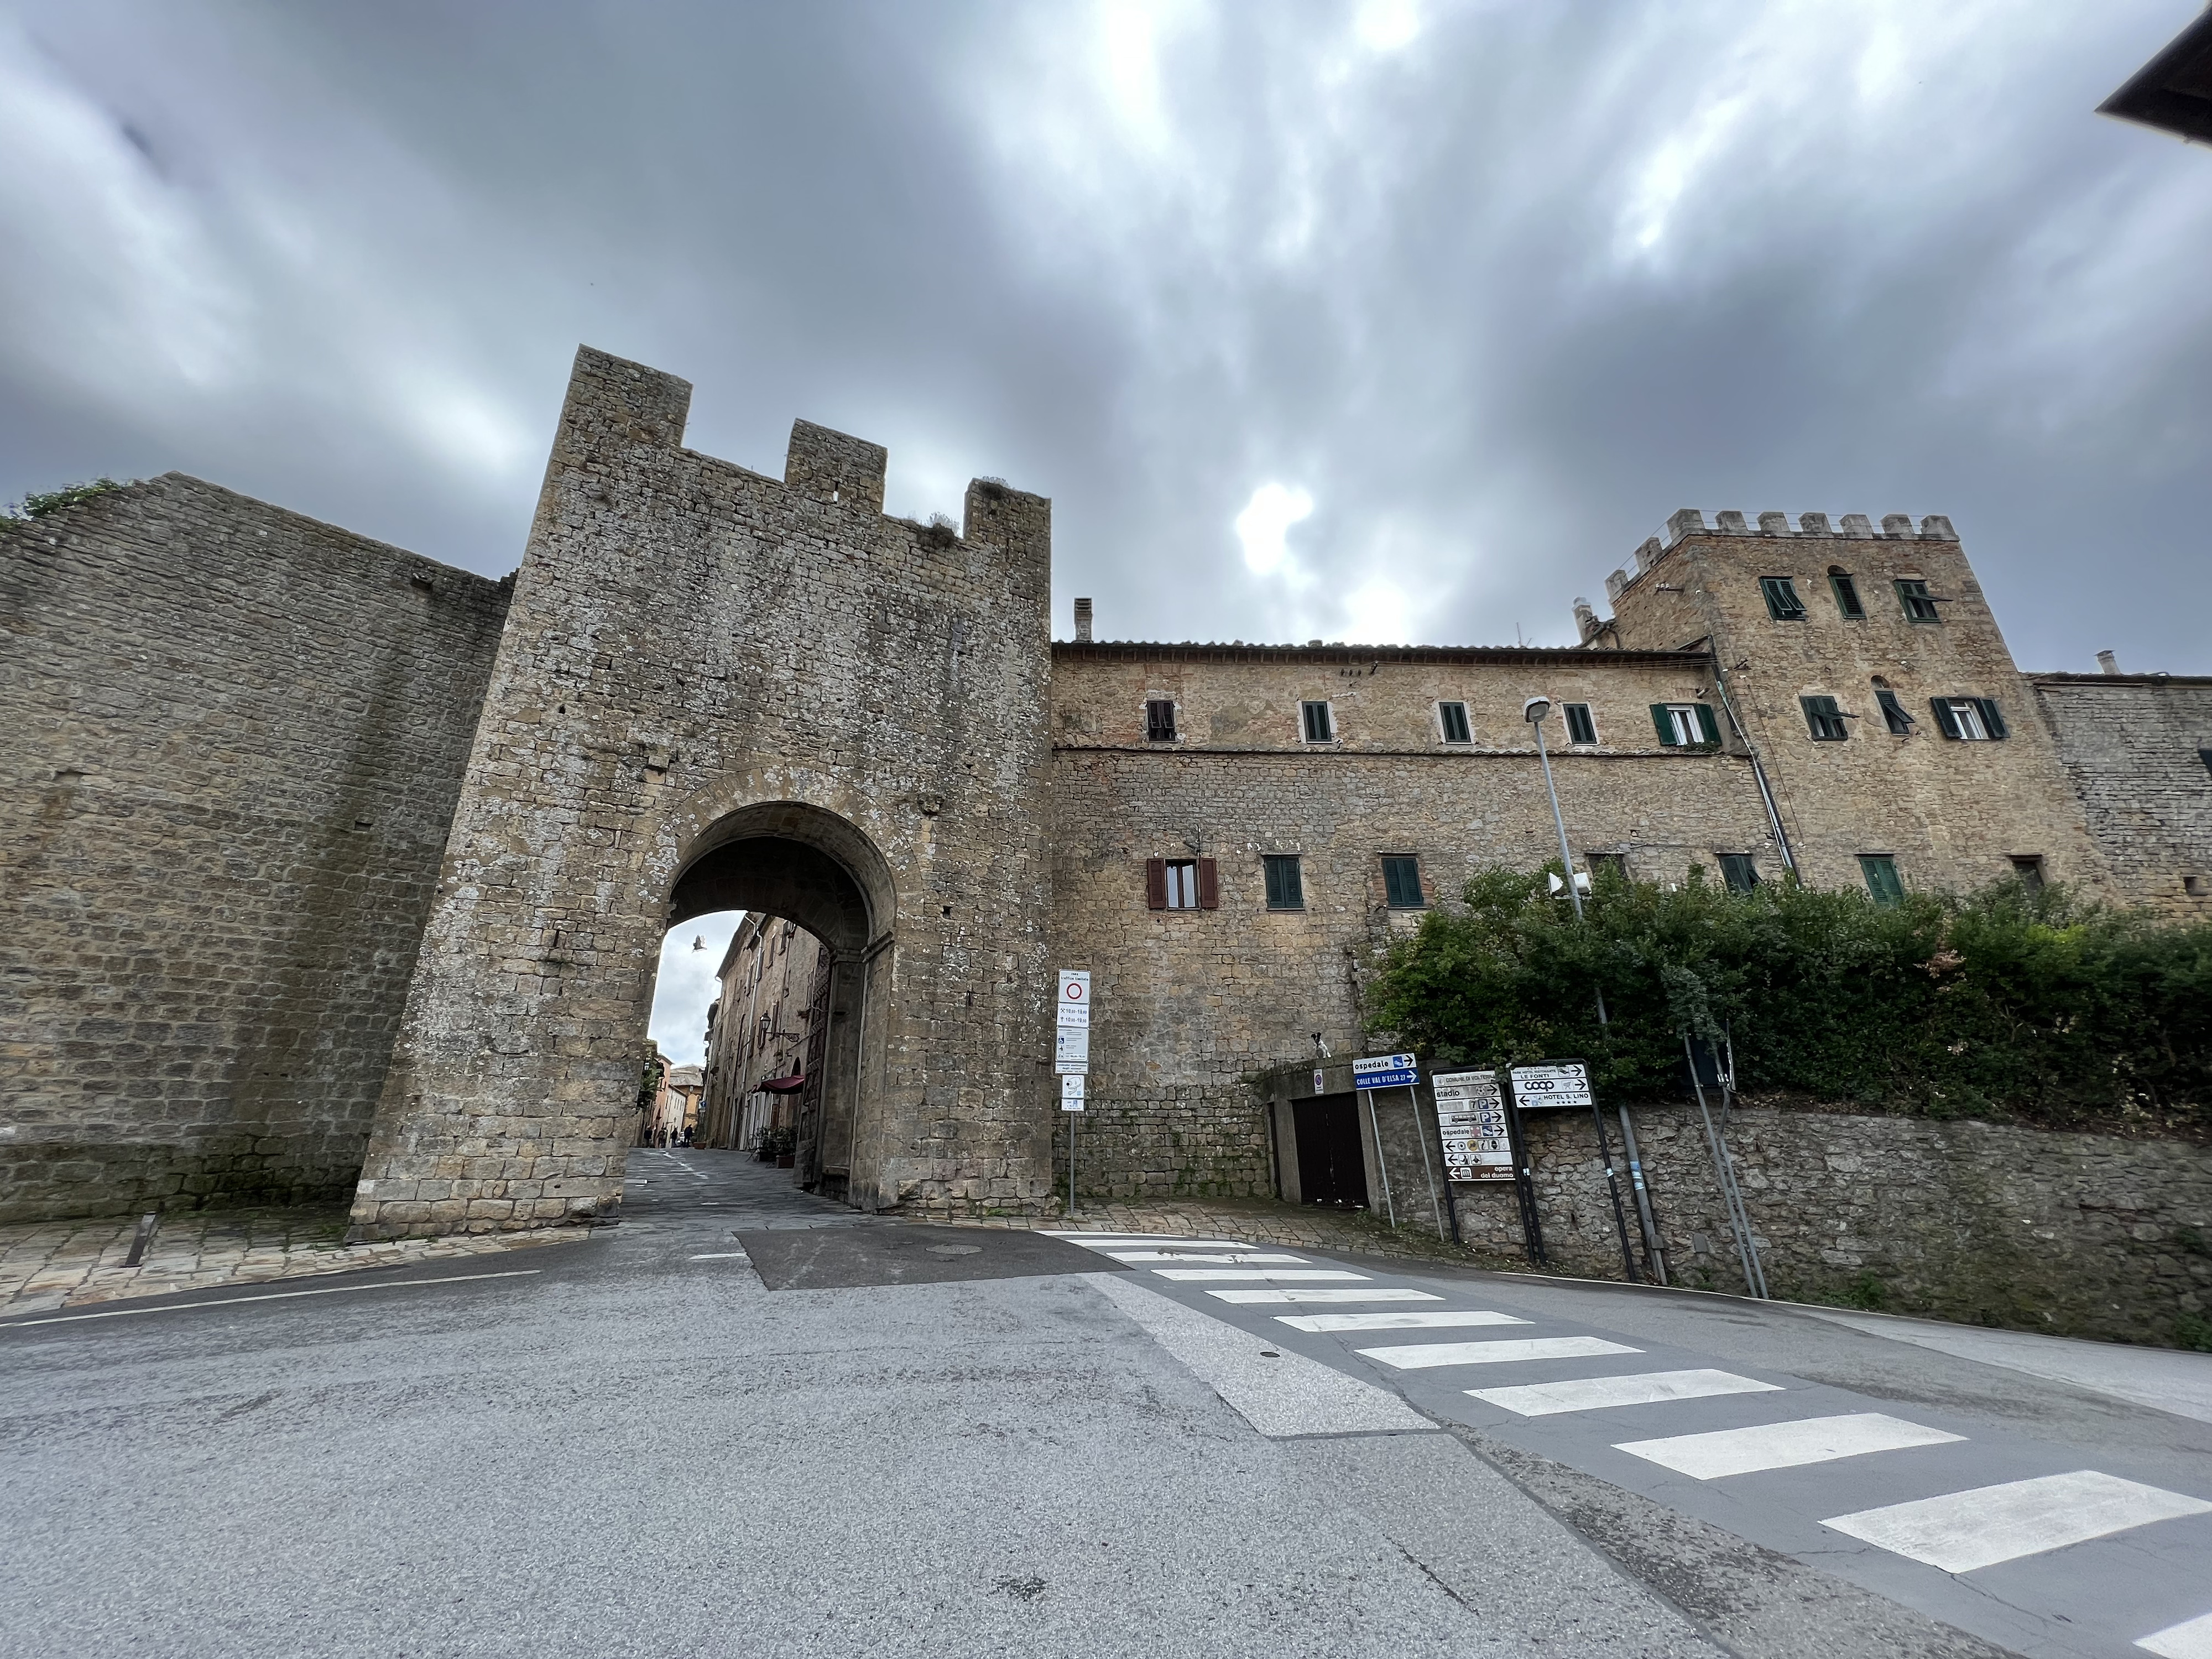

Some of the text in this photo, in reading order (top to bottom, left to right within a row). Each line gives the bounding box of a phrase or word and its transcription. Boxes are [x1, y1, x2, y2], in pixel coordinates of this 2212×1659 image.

[1355, 1060, 1389, 1070] ospedale
[1382, 1074, 1399, 1083] D'ELSA
[1437, 1089, 1460, 1098] stadio
[1470, 1100, 1476, 1109] 7
